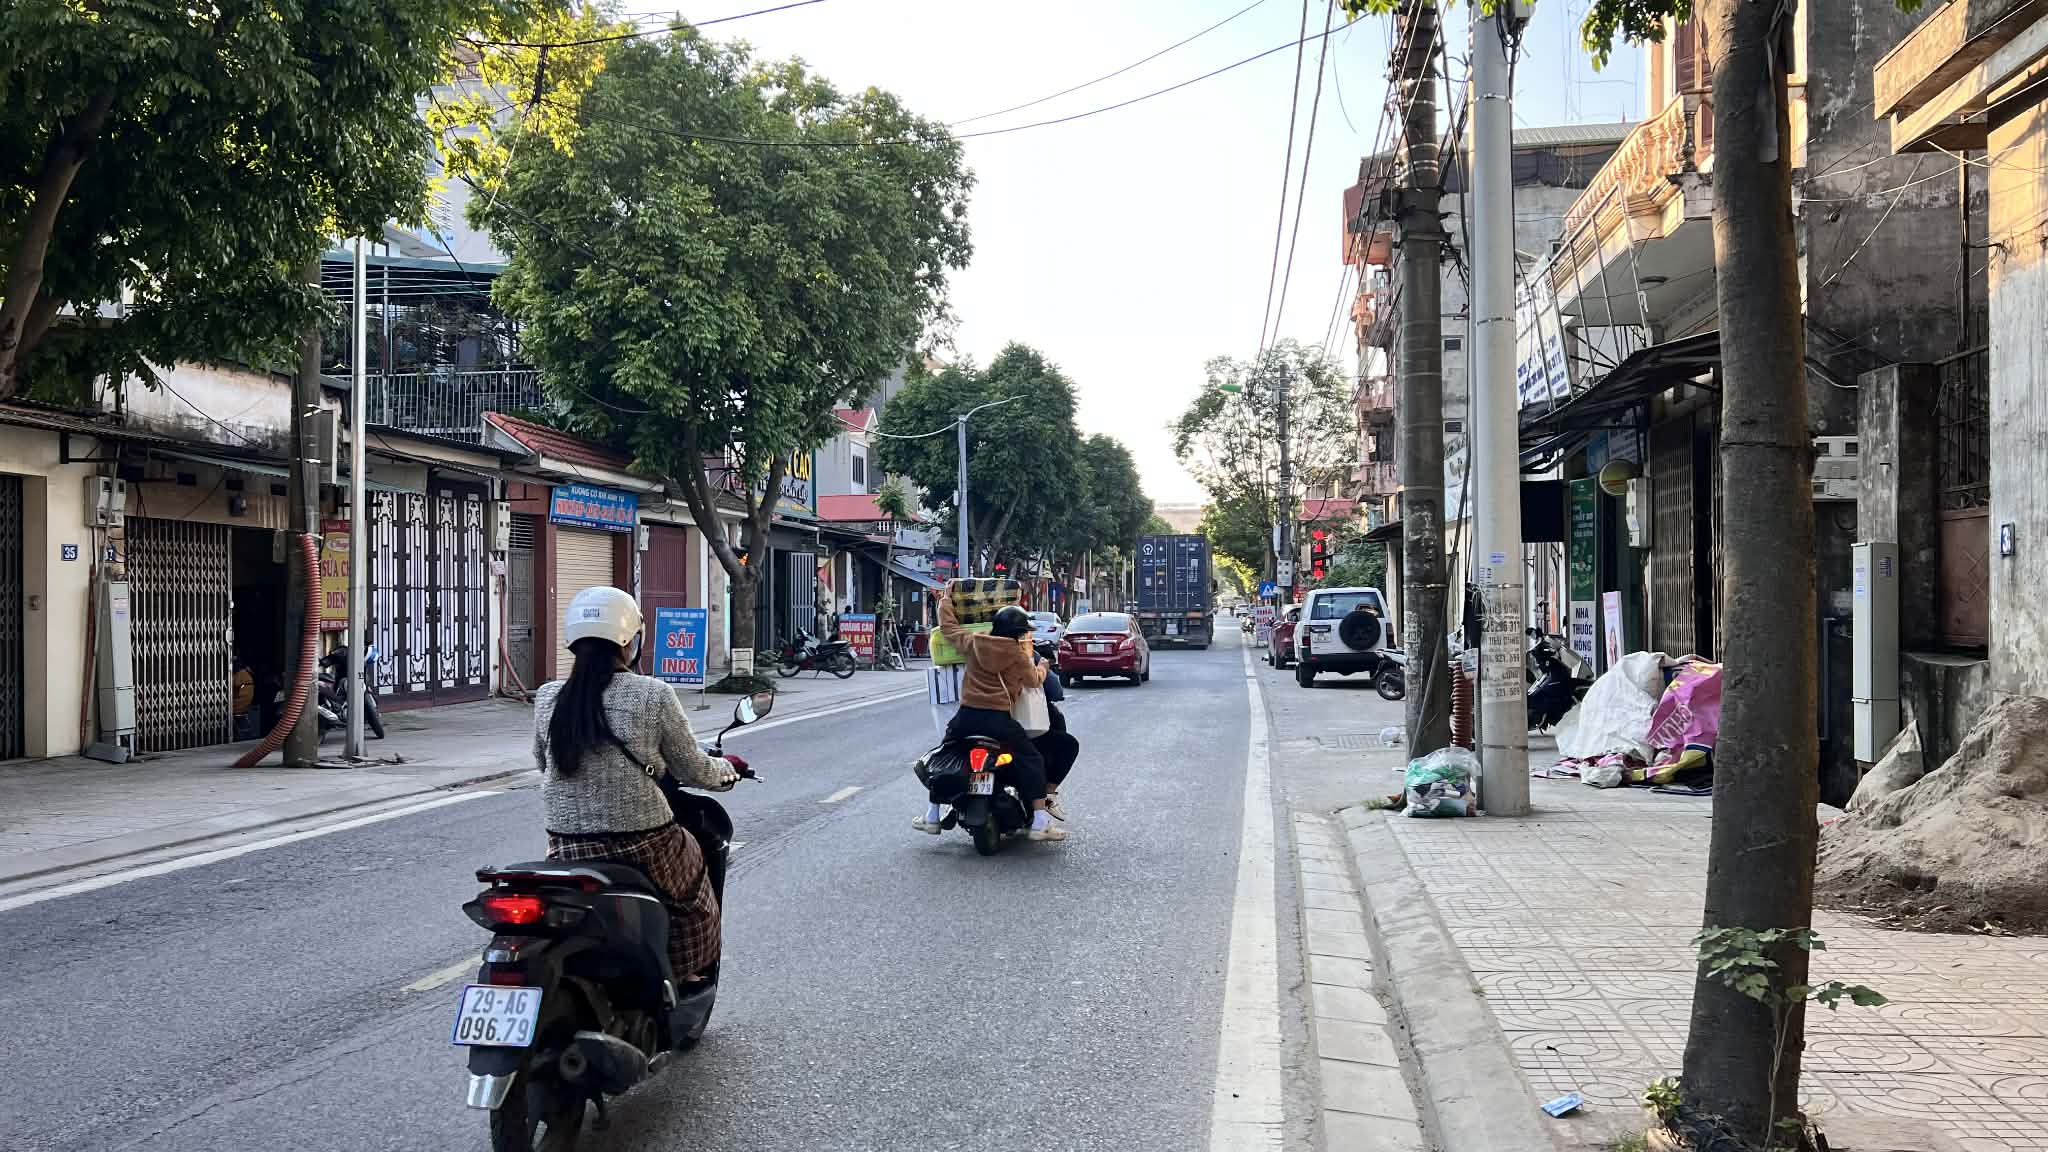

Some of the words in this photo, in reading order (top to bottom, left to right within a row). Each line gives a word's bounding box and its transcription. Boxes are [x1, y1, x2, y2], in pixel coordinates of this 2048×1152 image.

[64, 546, 76, 559] 35
[666, 627, 696, 649] SẮT
[661, 657, 697, 674] INOX
[471, 989, 529, 1015] 29-AG
[459, 1015, 530, 1043] 096.79
